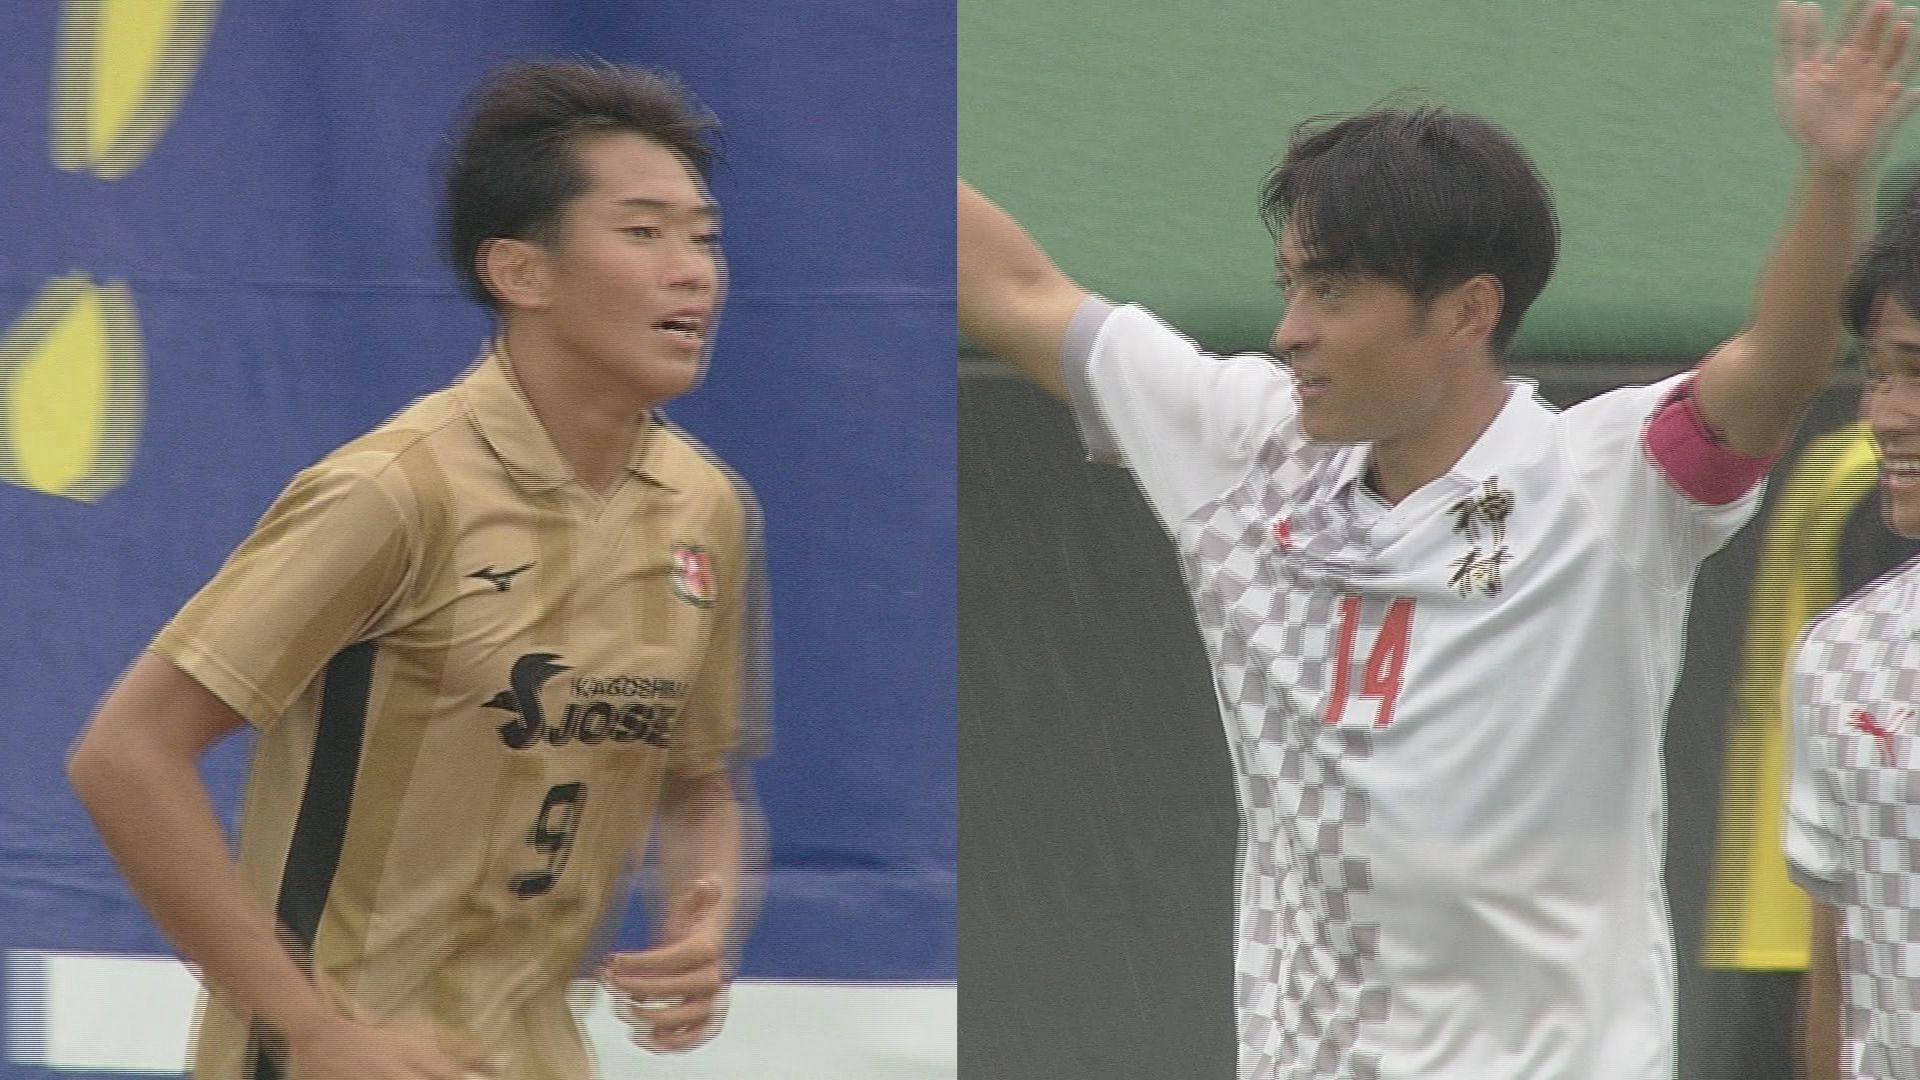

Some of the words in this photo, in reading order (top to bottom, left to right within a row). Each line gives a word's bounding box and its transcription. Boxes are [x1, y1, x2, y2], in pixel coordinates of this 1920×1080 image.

[1446, 475, 1516, 598] 神村
[1321, 593, 1418, 728] 14
[507, 782, 588, 900] 9
